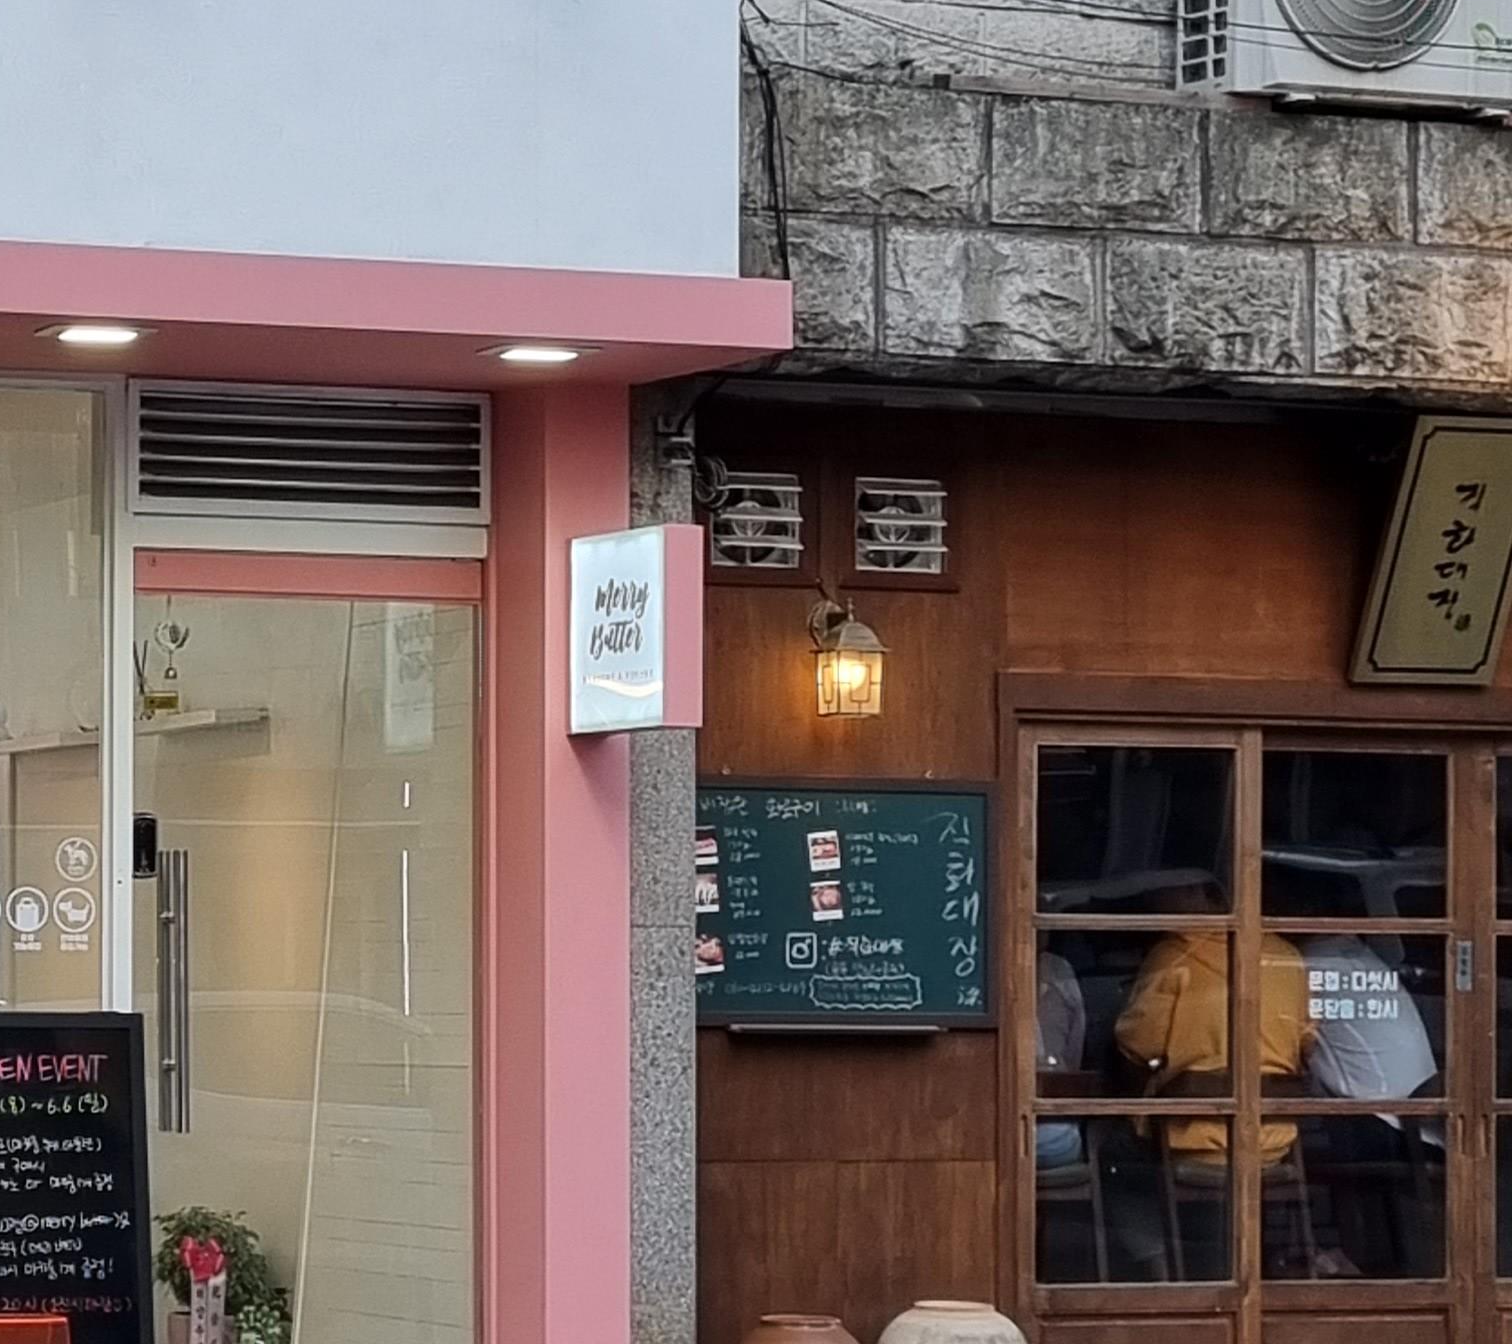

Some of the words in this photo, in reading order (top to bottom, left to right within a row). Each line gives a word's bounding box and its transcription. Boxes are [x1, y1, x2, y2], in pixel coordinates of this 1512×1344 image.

[595, 578, 649, 619] Merry
[590, 618, 644, 661] Butter
[37, 1054, 109, 1084] EVENT
